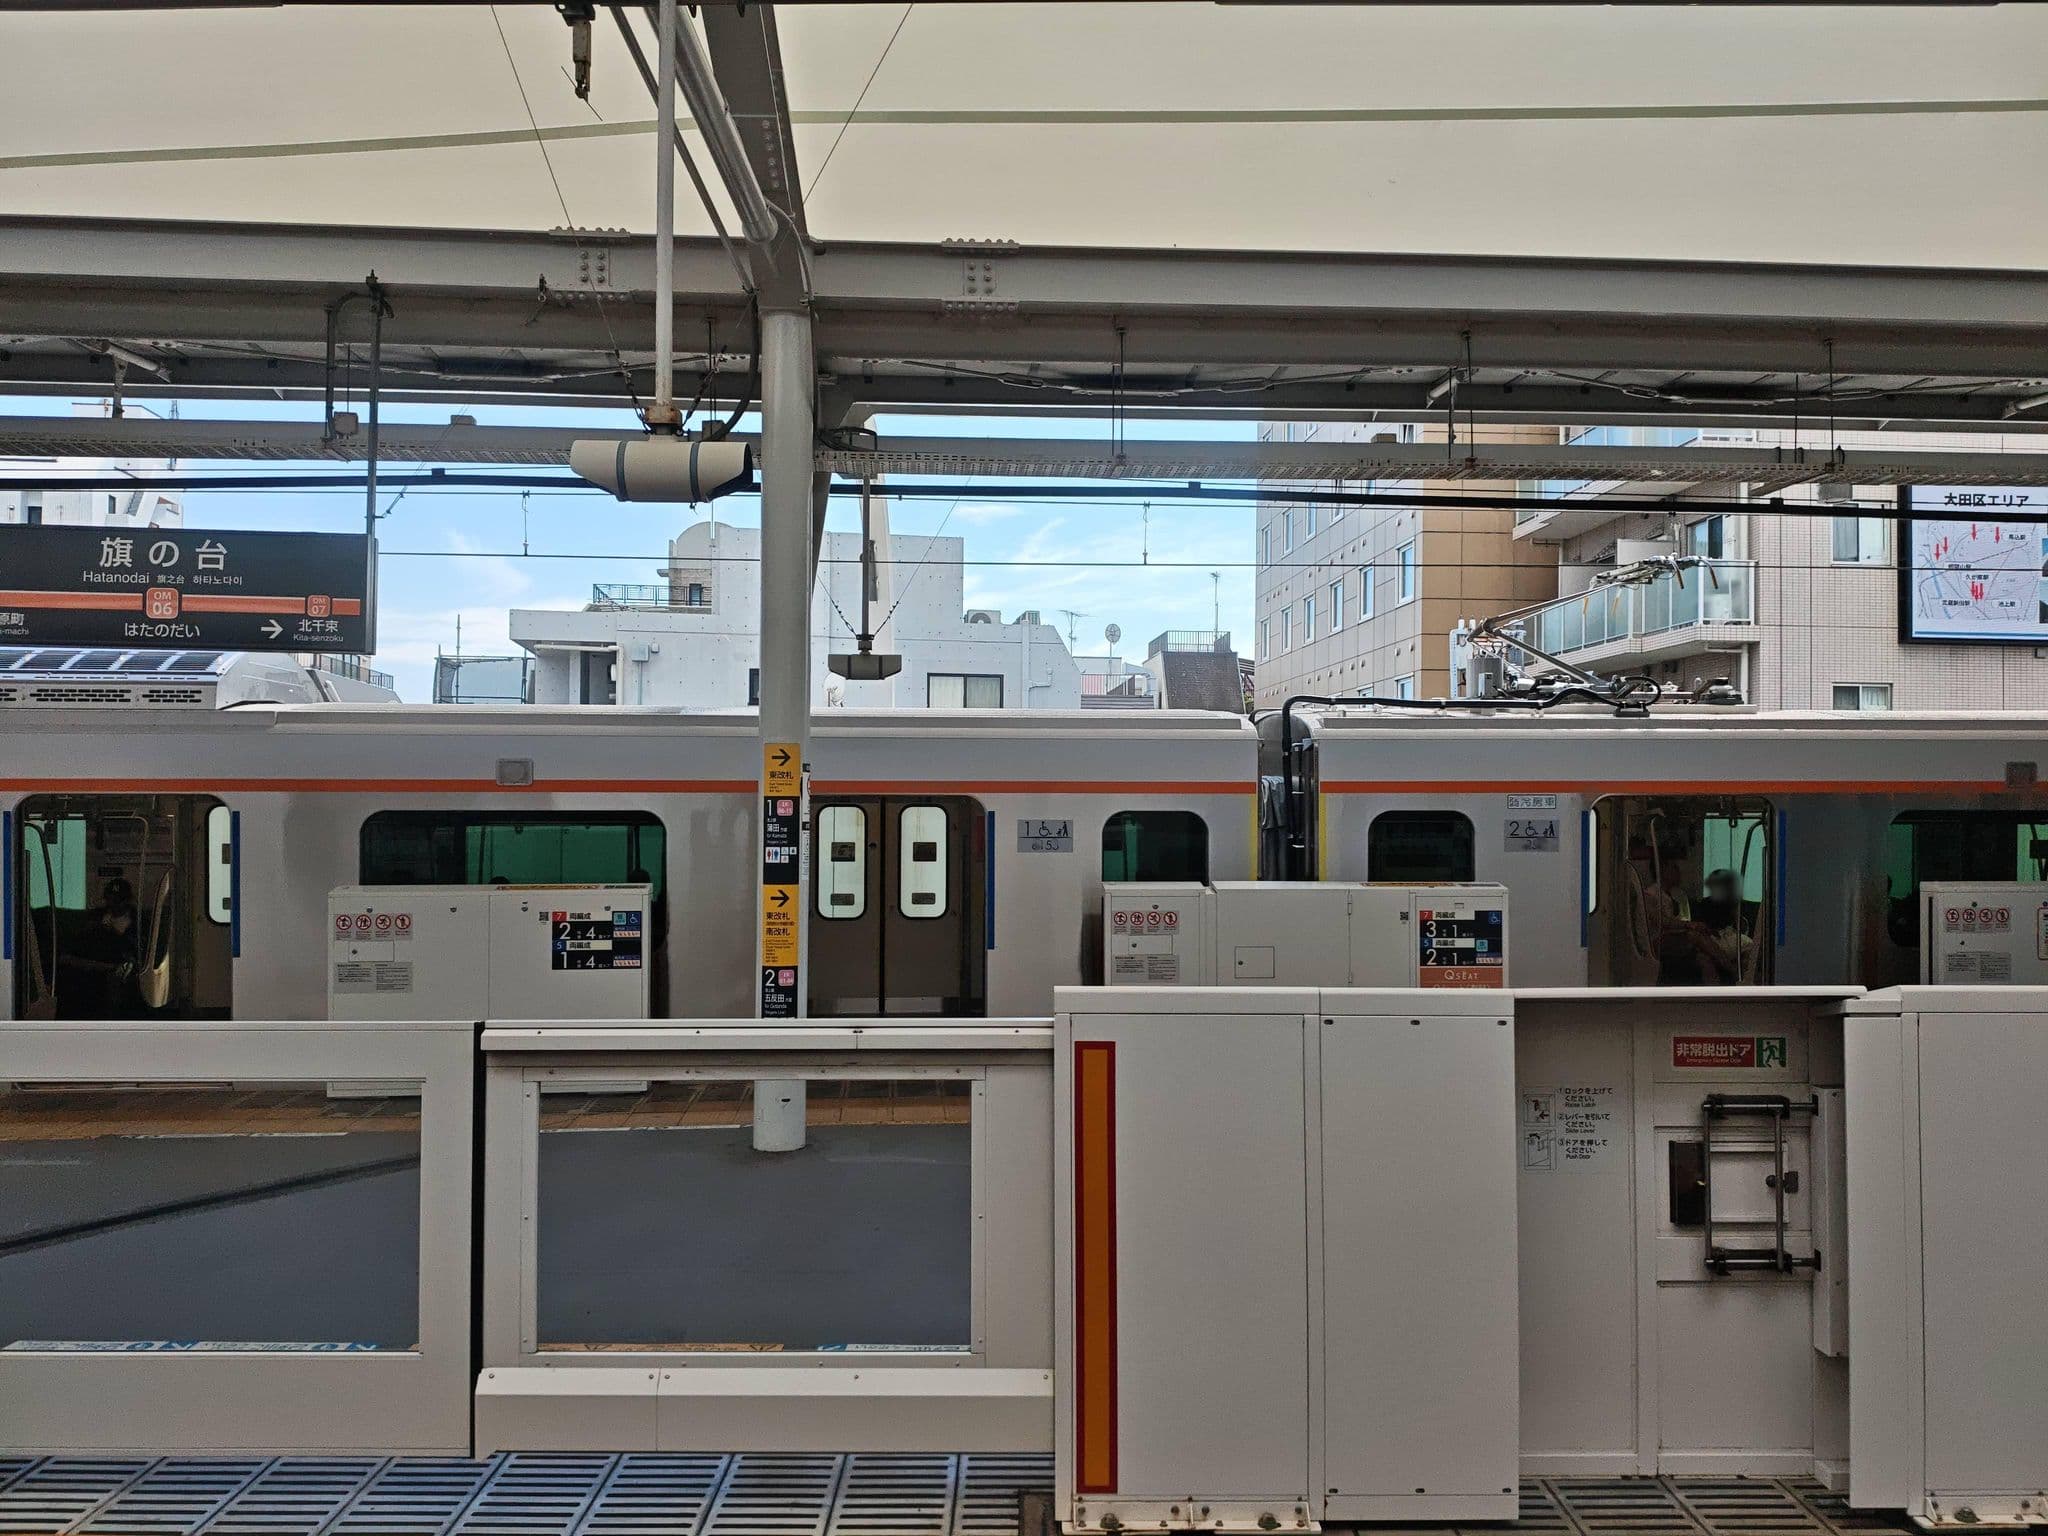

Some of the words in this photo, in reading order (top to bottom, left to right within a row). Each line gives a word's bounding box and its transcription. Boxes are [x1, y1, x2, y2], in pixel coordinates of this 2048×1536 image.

[1944, 492, 2029, 507] 大田区エリア
[100, 537, 228, 571] 旗の台
[83, 570, 150, 585] Hatanodai
[156, 575, 185, 585] 旗之台
[193, 575, 243, 586] 하타노다이
[154, 591, 172, 601] OM
[152, 602, 173, 616] 06
[311, 605, 326, 615] 07
[124, 622, 201, 638] はたのだい
[298, 619, 340, 633] 北千束
[293, 633, 344, 642] Kita-senzoku
[767, 799, 772, 817] 1
[1025, 821, 1030, 837] 1
[1509, 820, 1520, 837] 2
[557, 912, 562, 920] 7
[1423, 911, 1429, 919] 7
[559, 922, 571, 940] 2
[585, 926, 597, 939] 4
[1426, 920, 1437, 938] 3
[1452, 924, 1458, 938] 1
[556, 941, 563, 950] 5
[560, 951, 568, 969] 1
[585, 955, 597, 969] 4
[1426, 948, 1437, 966] 2
[1452, 952, 1458, 966] 1
[765, 969, 776, 987] 2
[1676, 1042, 1752, 1058] 非常脱出ドア
